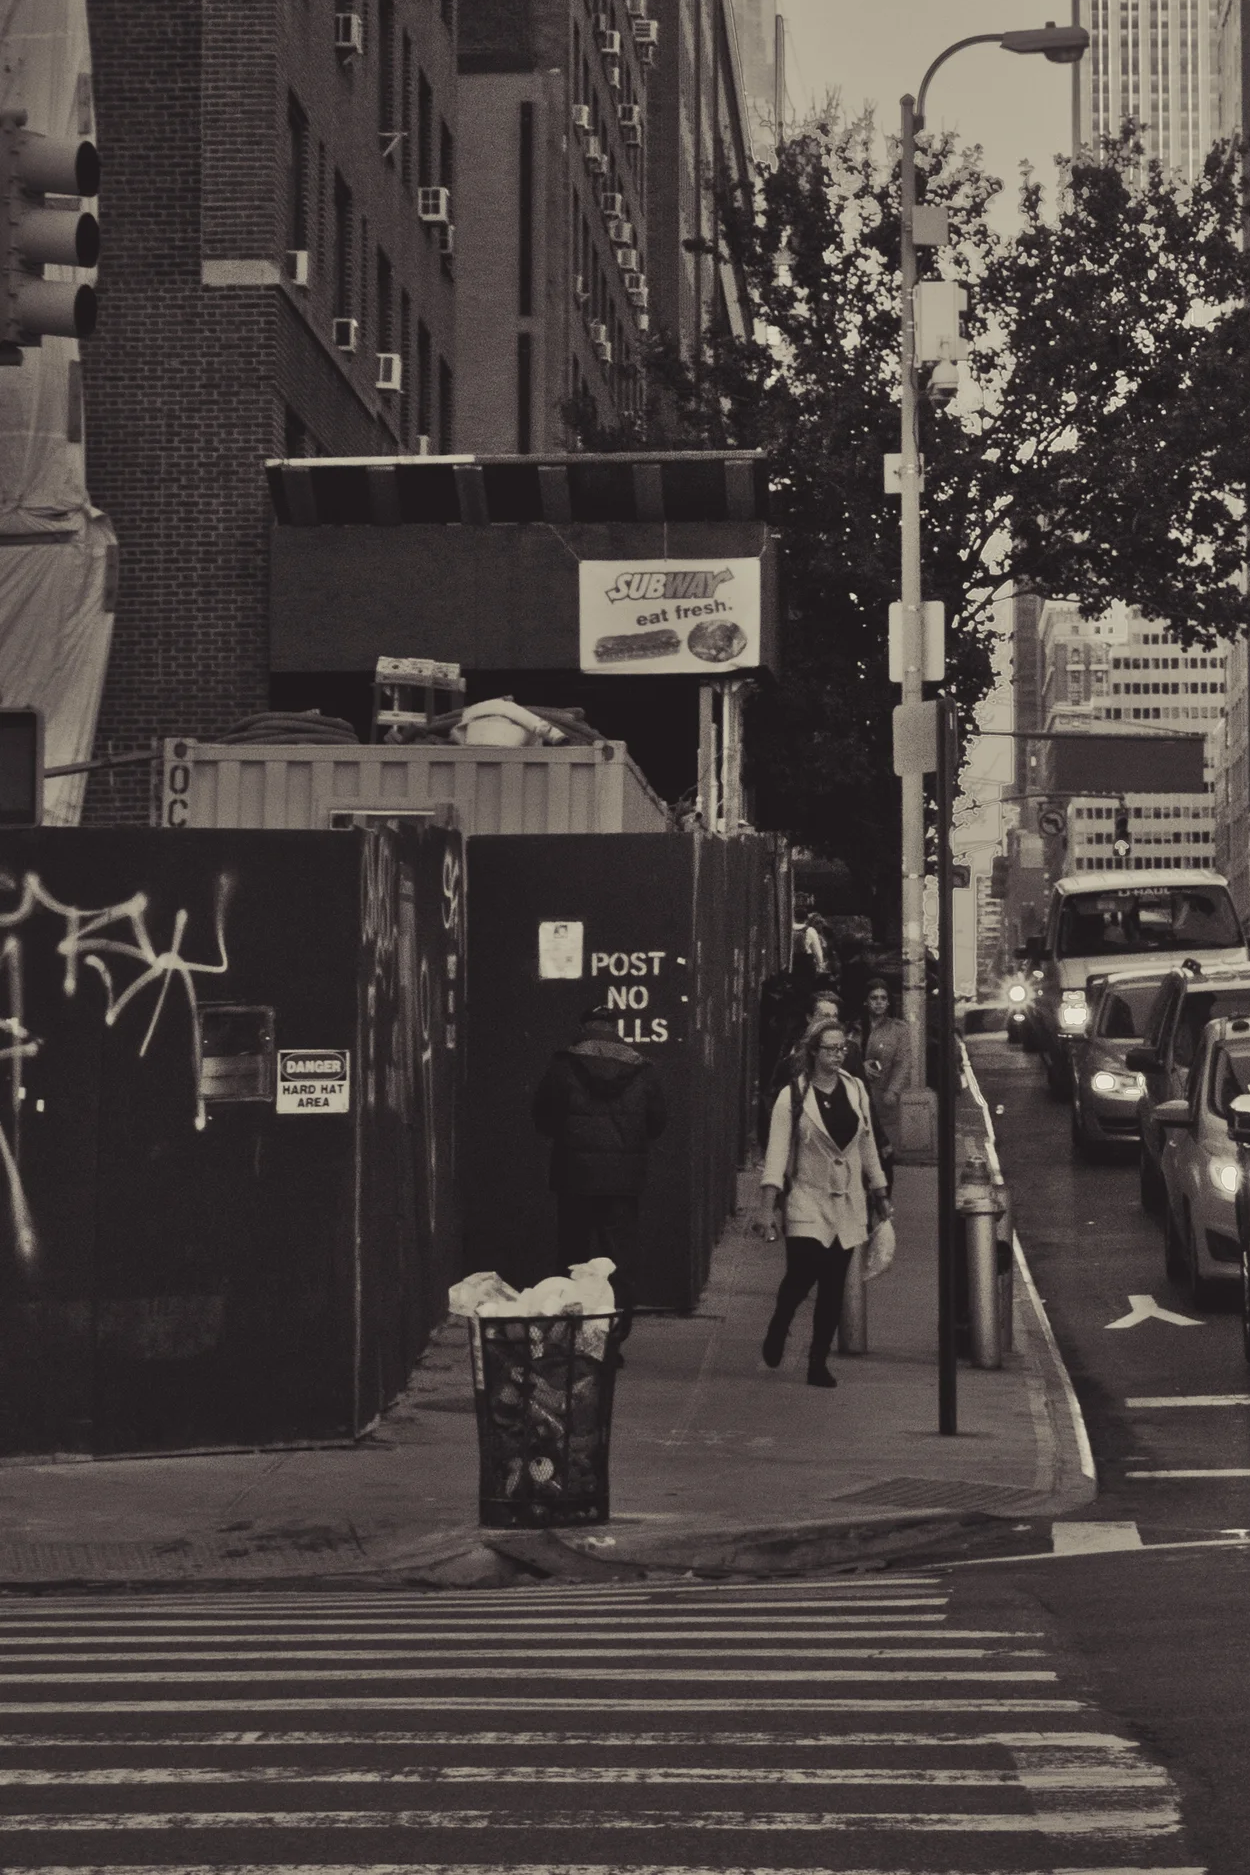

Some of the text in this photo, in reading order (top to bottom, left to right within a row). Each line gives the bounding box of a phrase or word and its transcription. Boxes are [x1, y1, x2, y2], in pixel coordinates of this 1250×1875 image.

[605, 568, 735, 604] SUBWAY
[636, 599, 733, 626] eat fresh.
[1117, 887, 1171, 897] U-HAUL
[591, 951, 666, 976] POST
[607, 985, 649, 1010] NO
[617, 1018, 669, 1043] LLS
[286, 1059, 342, 1073] DANGER
[282, 1084, 344, 1095] HARD HAT
[297, 1097, 330, 1107] AREA
